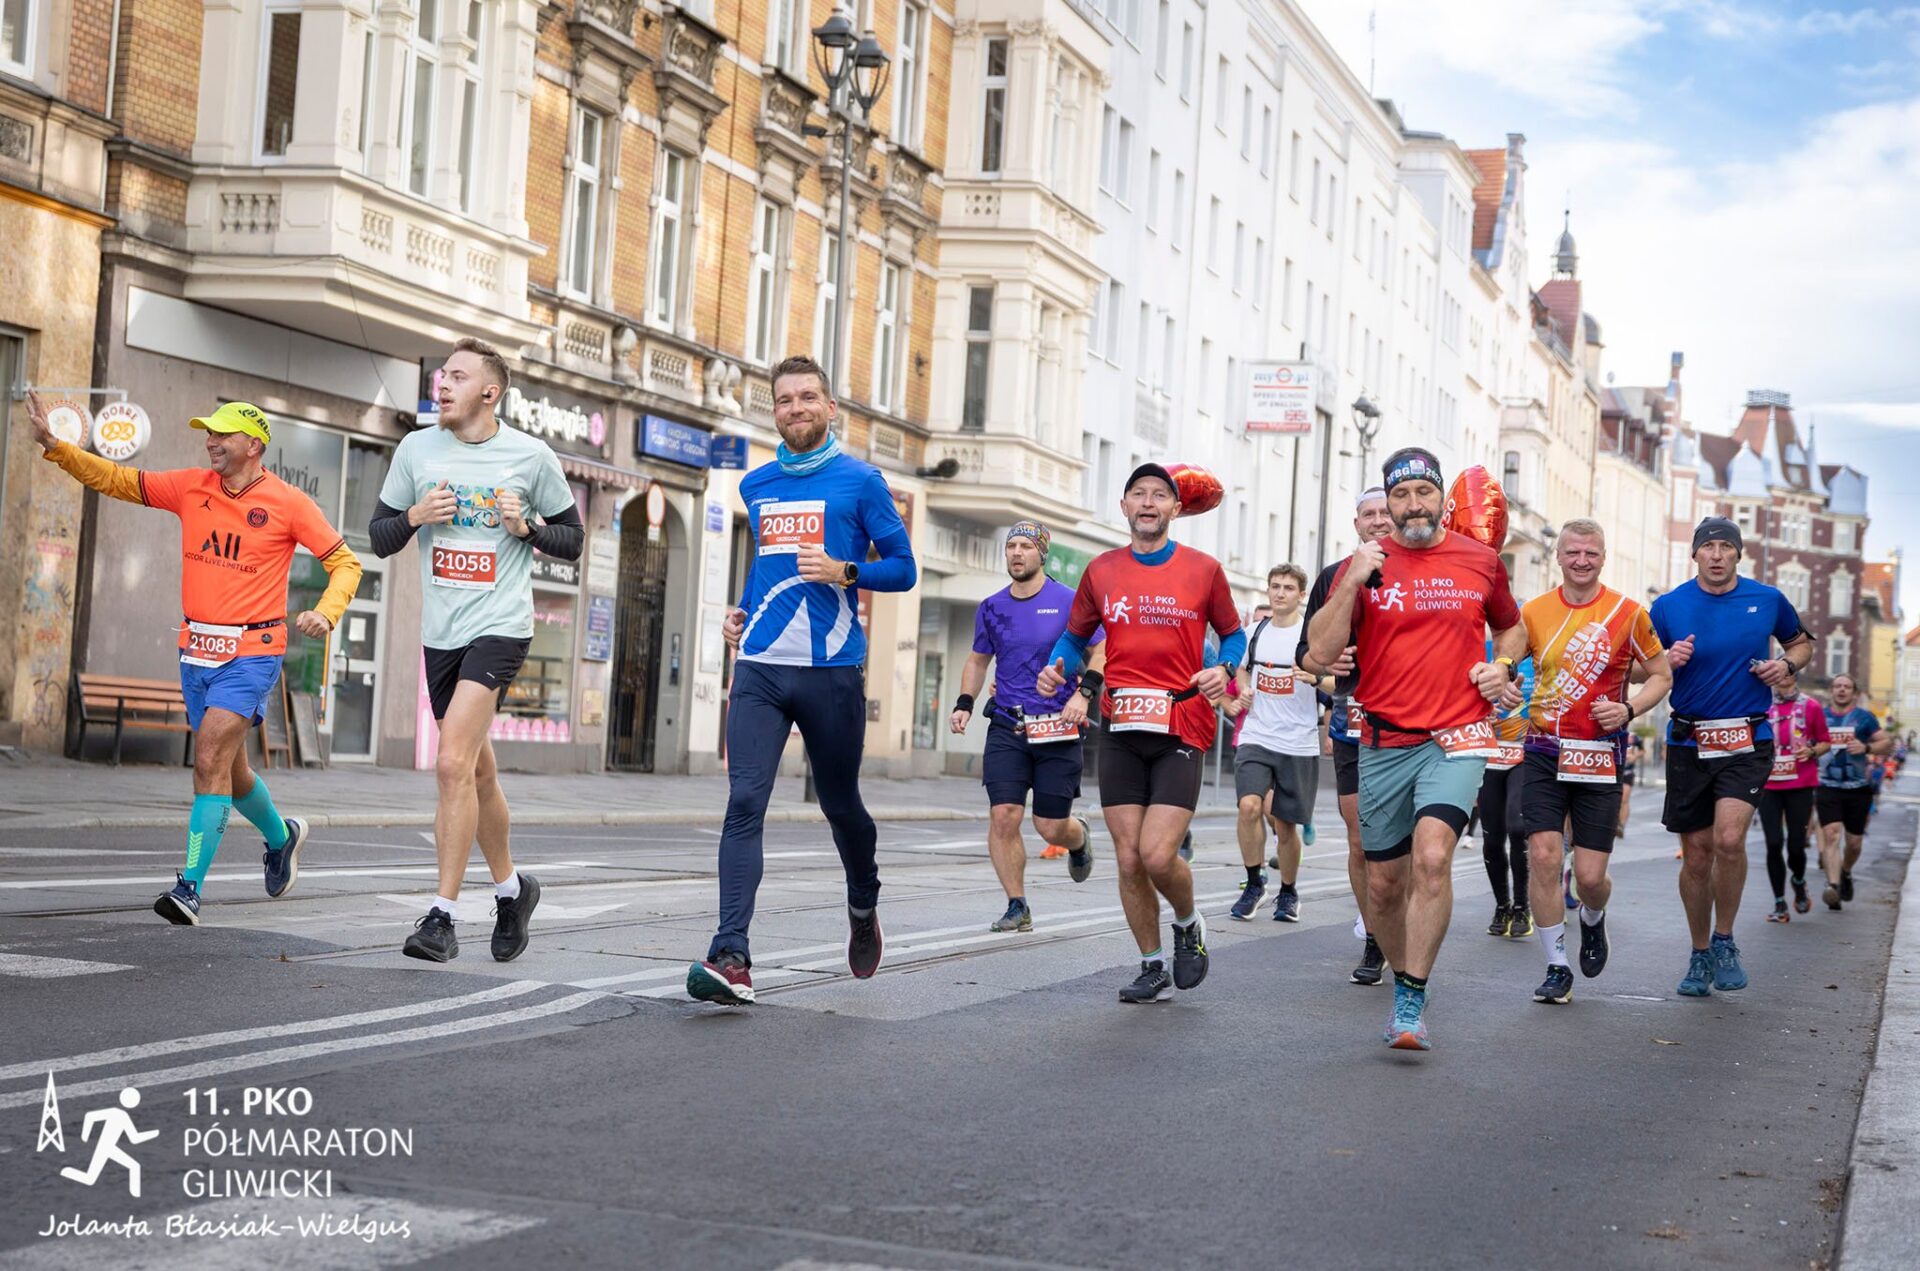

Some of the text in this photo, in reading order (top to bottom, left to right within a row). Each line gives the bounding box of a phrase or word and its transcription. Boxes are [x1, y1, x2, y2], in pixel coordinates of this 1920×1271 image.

[102, 406, 138, 421] DOBRE
[268, 447, 319, 497] aberia
[762, 515, 820, 536] 20810
[205, 556, 221, 567] LIVE
[221, 560, 258, 574] LIMITLESS
[435, 550, 491, 572] 21058
[1413, 578, 1454, 588] 11. PKO
[1138, 595, 1176, 606] 11. PKO
[1414, 588, 1483, 602] PÓŁMARATON
[1139, 605, 1199, 621] PÓŁMARATON
[1415, 601, 1462, 611] GLIWICKI
[1139, 615, 1182, 628] GLIWICKI
[189, 634, 237, 654] 21083
[1258, 674, 1292, 689] 21332
[1553, 667, 1588, 701] BBB
[1114, 697, 1168, 716] 21293
[1700, 729, 1748, 745] 21388
[1562, 751, 1612, 768] 20698
